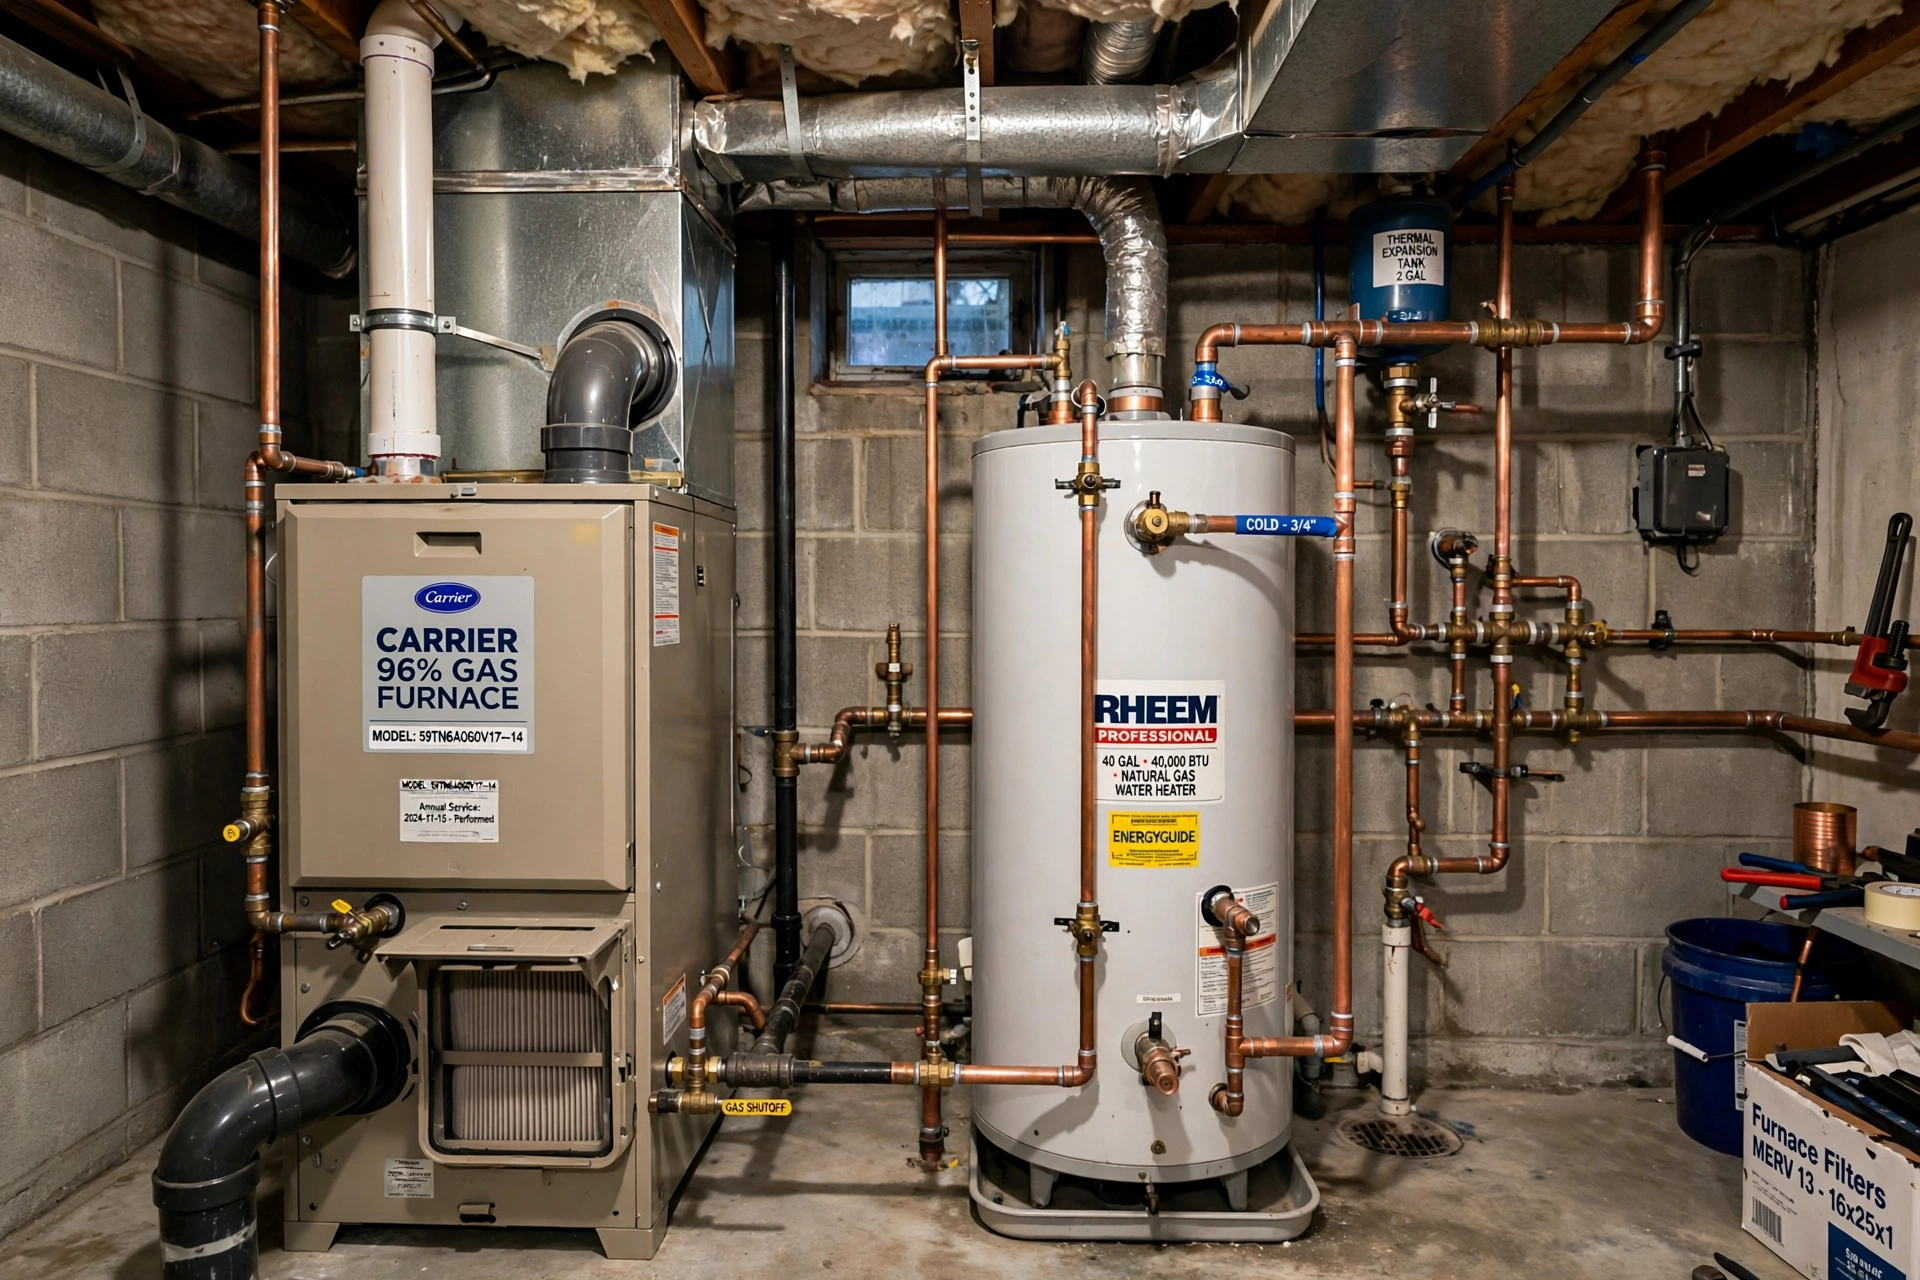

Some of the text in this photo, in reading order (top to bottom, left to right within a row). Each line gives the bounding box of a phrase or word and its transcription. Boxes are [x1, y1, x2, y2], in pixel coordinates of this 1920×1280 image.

[1387, 232, 1435, 245] THERMAL
[1382, 245, 1438, 258] EXPANSION
[1397, 257, 1426, 269] TANK
[1396, 270, 1427, 281] 2 GAL
[1246, 517, 1279, 531] COLD
[1290, 518, 1317, 534] 3/4"
[425, 590, 473, 605] Carrier
[376, 626, 519, 653] CARRIER
[377, 657, 518, 683] 96% GAS
[377, 686, 519, 710] FURNACE
[1095, 694, 1218, 724] RHEEM
[372, 730, 417, 743] MODEL:
[1098, 729, 1214, 742] PROFESSIONAL
[1102, 755, 1209, 769] 40 GAL 40,000 BTU
[1121, 770, 1196, 782] NATURAL GAS
[1115, 784, 1196, 796] WATER HEATER
[419, 802, 481, 812] Annual Service:
[404, 813, 447, 823] 2024-11-15
[454, 814, 495, 824] Performed
[1113, 830, 1196, 844] ENERGYGUIDE
[725, 1102, 787, 1113] GAS SHUTOFF
[1752, 1101, 1819, 1166] Furnace
[1824, 1147, 1887, 1210] Filters
[1752, 1134, 1794, 1180] MERV
[1797, 1166, 1815, 1196] 13
[1829, 1188, 1893, 1251] 16x25x1
